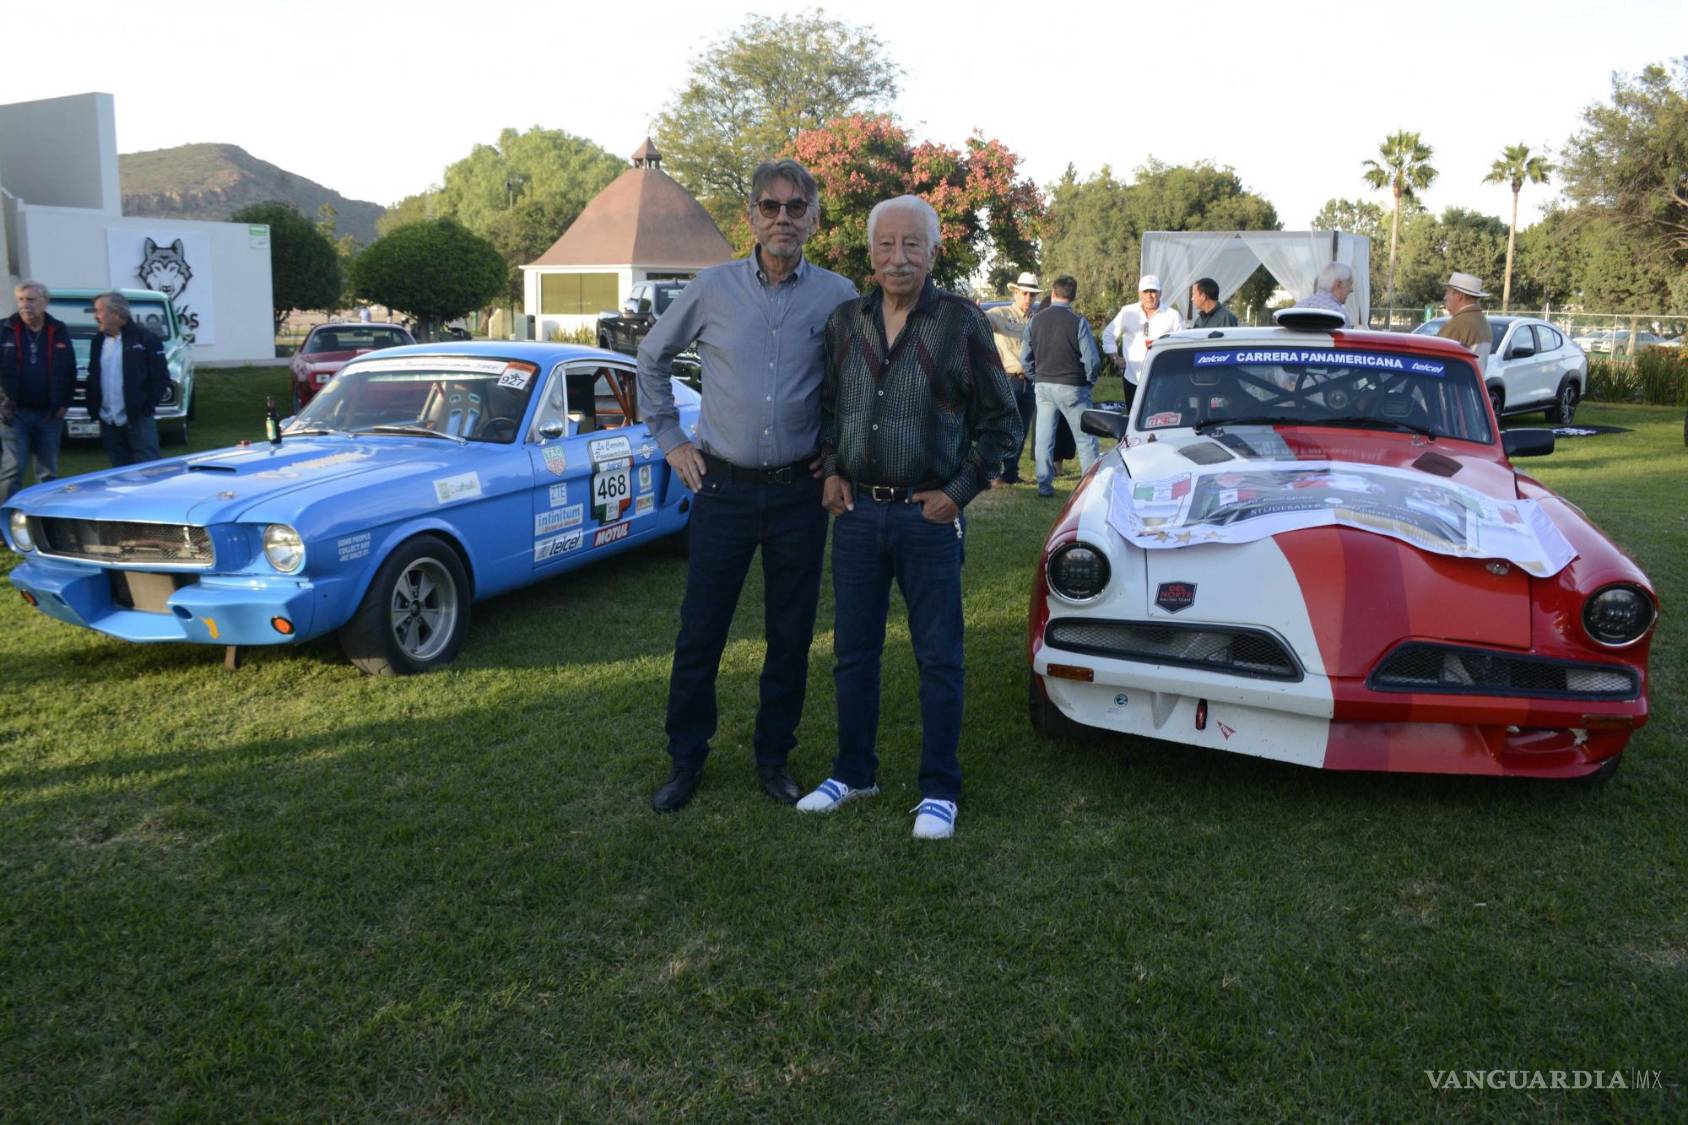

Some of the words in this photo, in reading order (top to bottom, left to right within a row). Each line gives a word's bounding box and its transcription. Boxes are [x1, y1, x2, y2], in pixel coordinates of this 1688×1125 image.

[1198, 354, 1230, 363] telcel
[1236, 352, 1299, 362] CARRERA
[1301, 353, 1404, 369] PANAMERICANA
[1411, 362, 1444, 373] telcel
[502, 375, 526, 387] 927
[551, 485, 566, 500] ZTE
[597, 474, 626, 499] 468
[538, 507, 581, 527] infinitum
[549, 532, 581, 556] telcel
[594, 522, 629, 546] MOTUL
